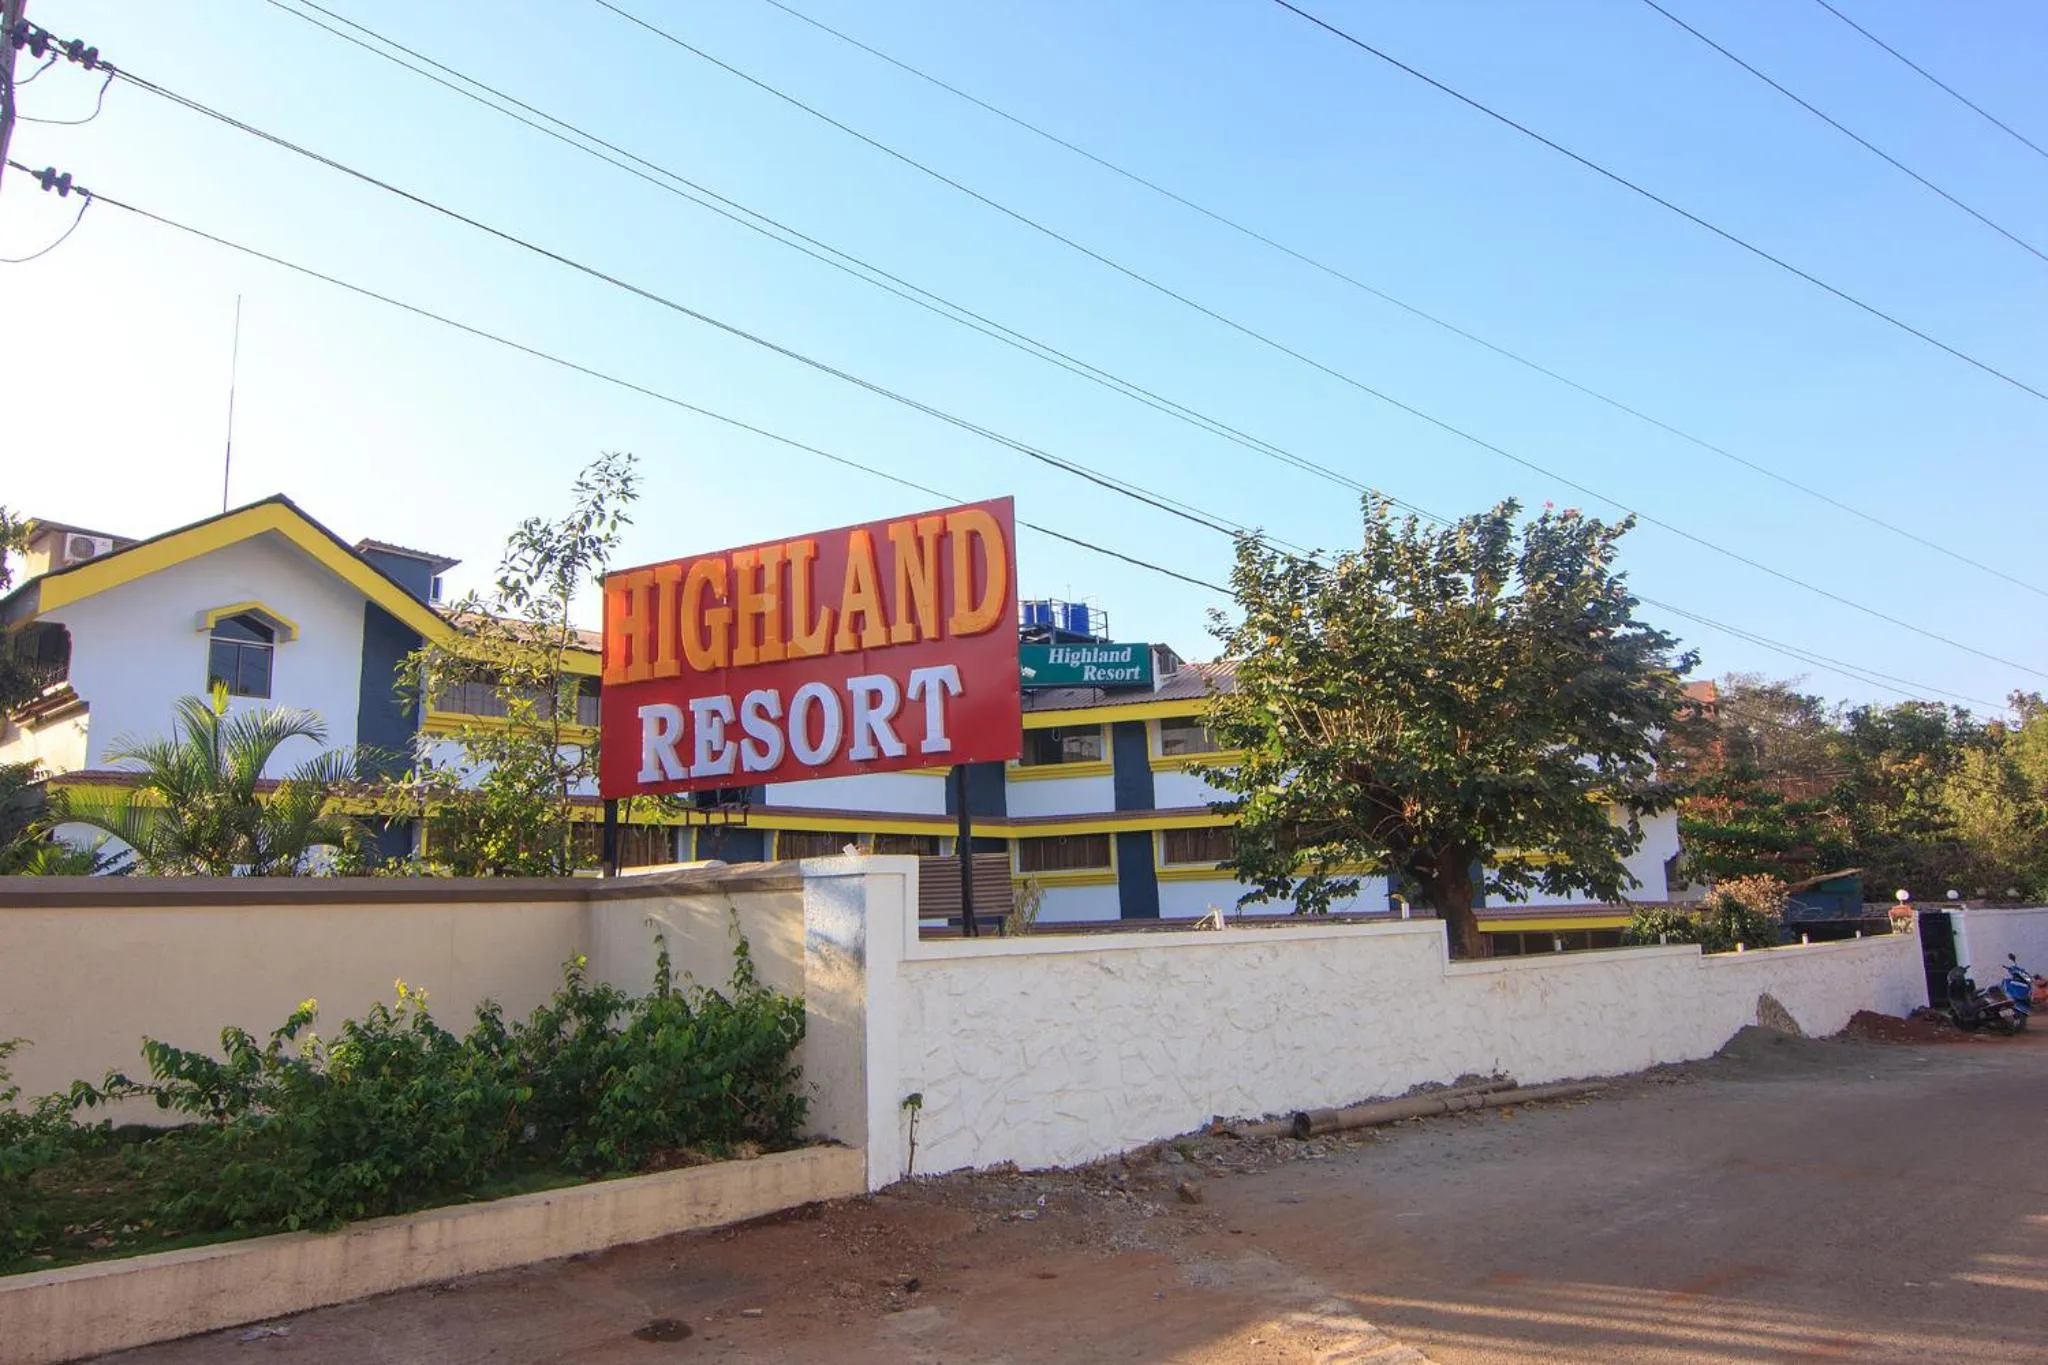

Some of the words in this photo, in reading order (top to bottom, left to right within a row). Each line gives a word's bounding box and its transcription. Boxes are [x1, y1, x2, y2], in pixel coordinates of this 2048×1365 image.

[603, 509, 1007, 685] HIGHLAND
[1048, 647, 1131, 667] Highland
[1083, 665, 1140, 681] Resort
[637, 664, 963, 783] RESORT
